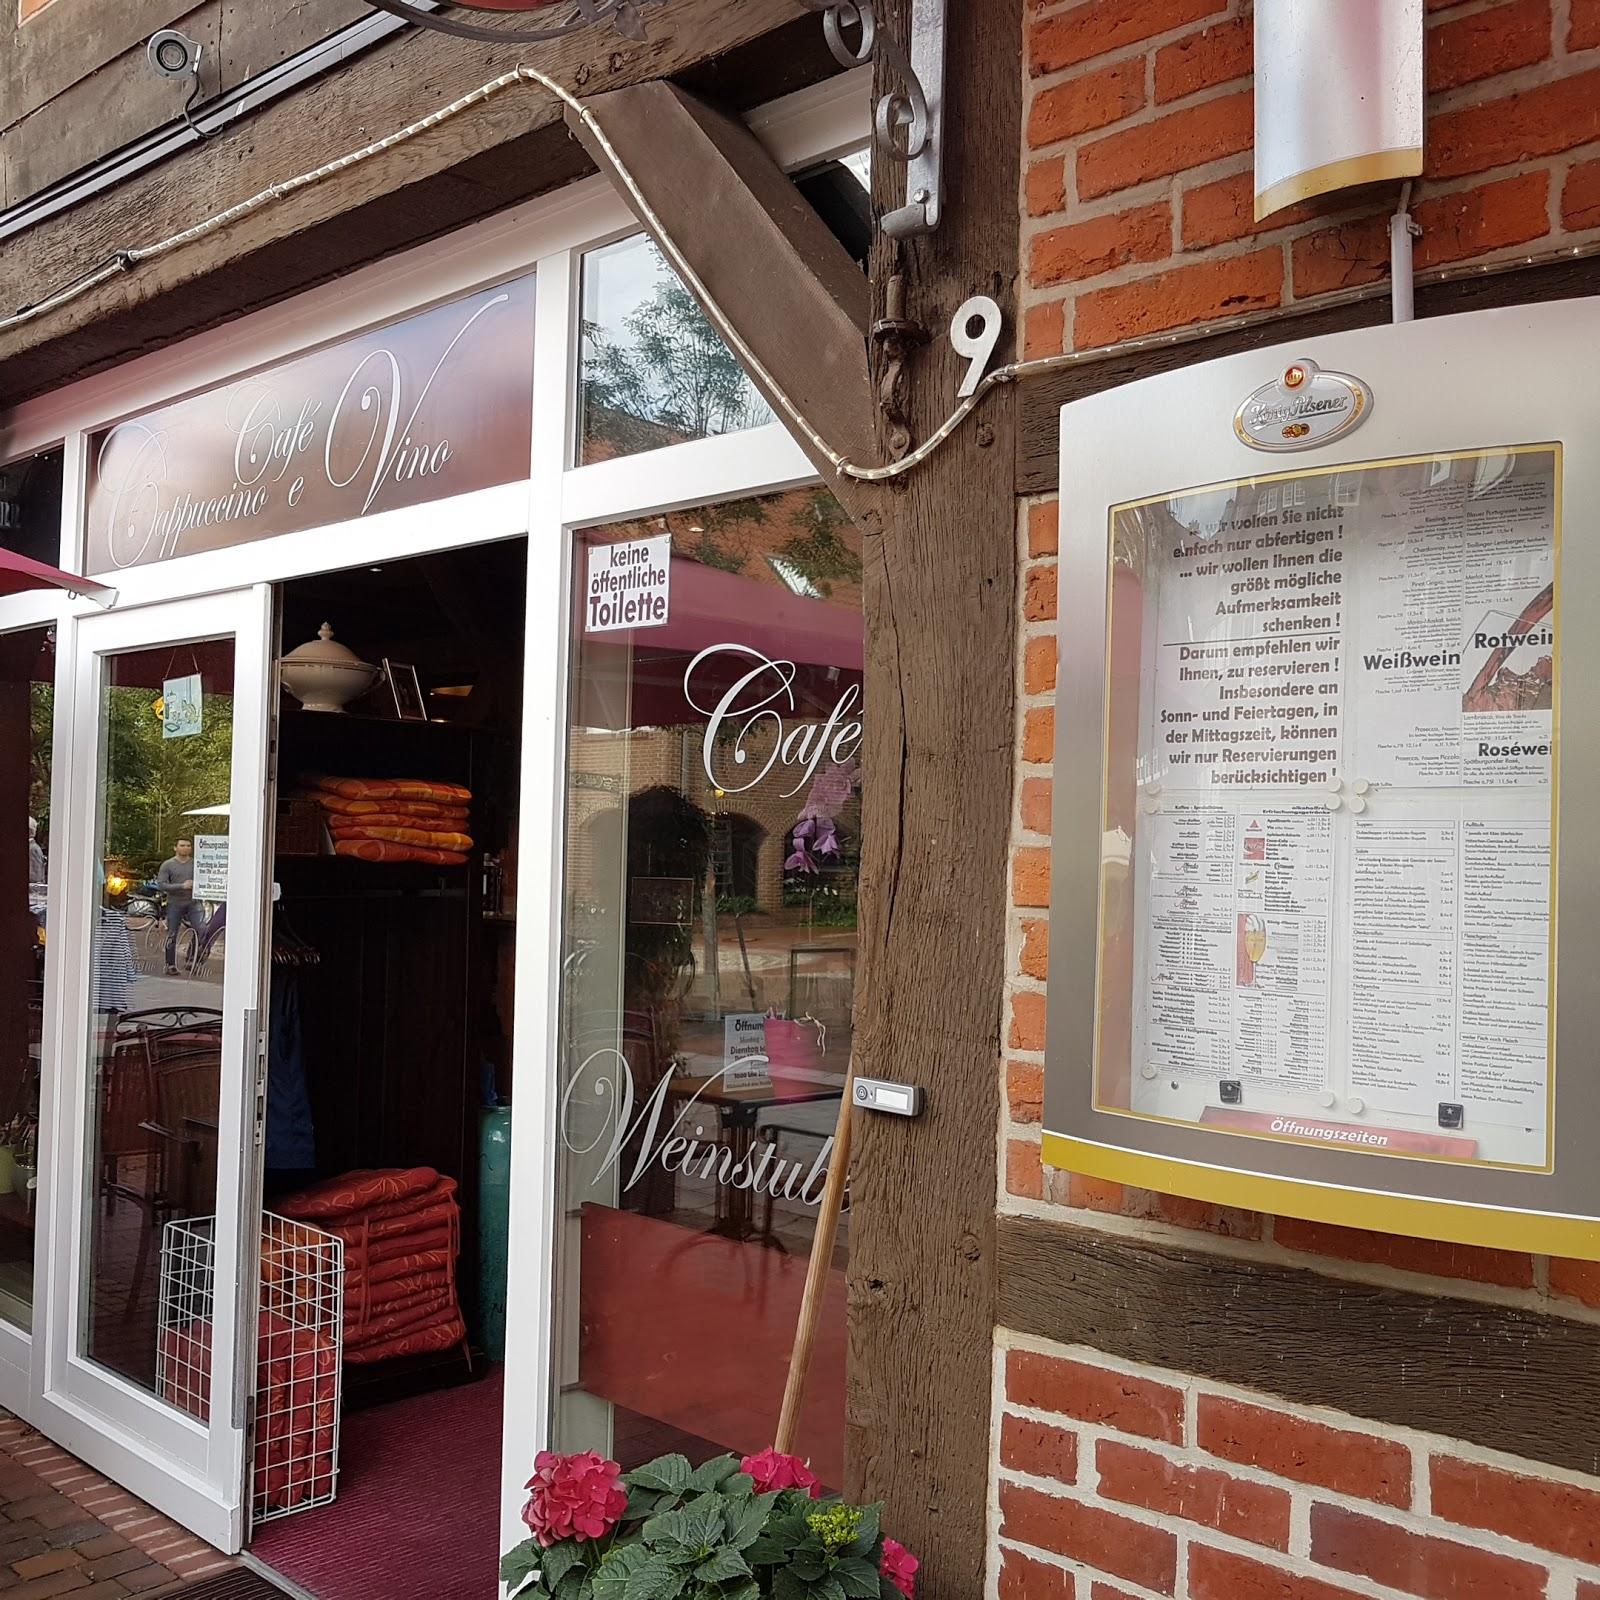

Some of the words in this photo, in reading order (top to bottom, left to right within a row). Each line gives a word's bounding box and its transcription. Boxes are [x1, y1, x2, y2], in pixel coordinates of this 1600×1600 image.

[950, 295, 1002, 397] 9
[97, 421, 269, 568] Cappuccino
[287, 475, 304, 507] e
[324, 293, 508, 516] Vino
[225, 381, 322, 486] Café
[1282, 512, 1303, 525] Sie
[1306, 505, 1344, 522] nicht
[1173, 540, 1223, 558] einfach
[1226, 540, 1252, 552] nur
[1256, 528, 1334, 548] abfertigen
[610, 544, 650, 568] keine
[1196, 562, 1219, 575] wir
[1222, 557, 1269, 573] wollen
[1273, 554, 1315, 568] Ihnen
[1319, 549, 1343, 562] die
[591, 564, 666, 595] öffentliche
[1231, 576, 1270, 595] größt
[1274, 571, 1342, 591] mögliche
[589, 591, 666, 628] Toilette
[1215, 592, 1342, 615] Aufmerksamkeit
[1262, 616, 1331, 632] schenken
[1179, 646, 1229, 660] Darum
[1232, 640, 1311, 658] empfehlen
[1315, 636, 1341, 651] wir
[1363, 650, 1461, 670] Weißwein
[1179, 667, 1223, 681] Ihnen,
[1226, 668, 1245, 678] zu
[1248, 661, 1330, 677] reservieren
[1219, 683, 1314, 699] Insbesondere
[1318, 683, 1338, 694] an
[684, 643, 864, 797] Café
[1160, 710, 1198, 723] Sonn-
[1202, 707, 1230, 721] und
[1234, 705, 1319, 721] Feiertagen,
[1323, 703, 1338, 716] in
[1165, 730, 1188, 743] der
[1191, 727, 1276, 743] Mittagszeit,
[1280, 725, 1337, 740] können
[1169, 750, 1191, 763] wir
[1194, 752, 1218, 763] nur
[1222, 749, 1337, 765] Reservierungen
[1211, 768, 1327, 784] berücksichtigen
[735, 1019, 765, 1033] Öffnun
[561, 1048, 850, 1213] Weinstub
[1270, 1115, 1388, 1146] Öffnungszeiten
